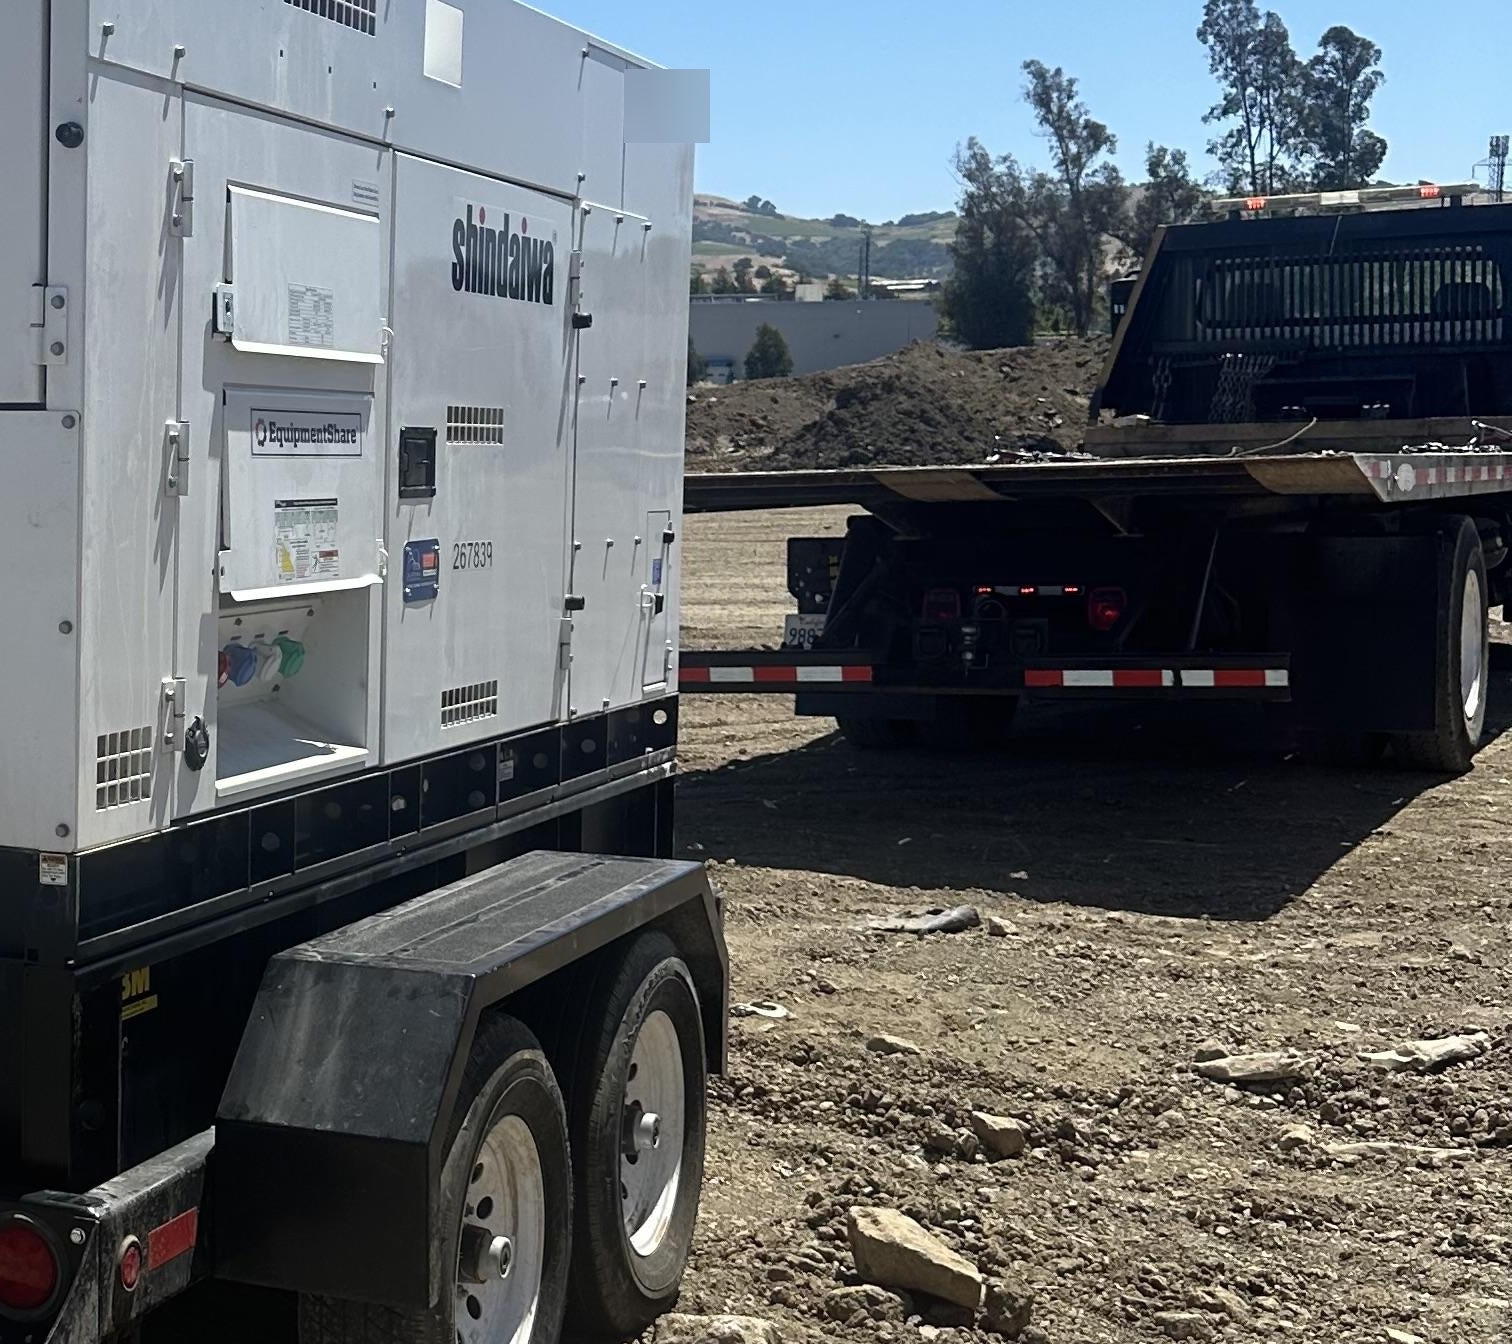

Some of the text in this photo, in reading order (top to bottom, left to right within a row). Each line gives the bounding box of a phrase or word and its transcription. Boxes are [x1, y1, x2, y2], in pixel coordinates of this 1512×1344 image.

[451, 204, 554, 305] shindaiwa
[268, 421, 357, 448] EquipmentShare
[452, 541, 493, 570] 267839
